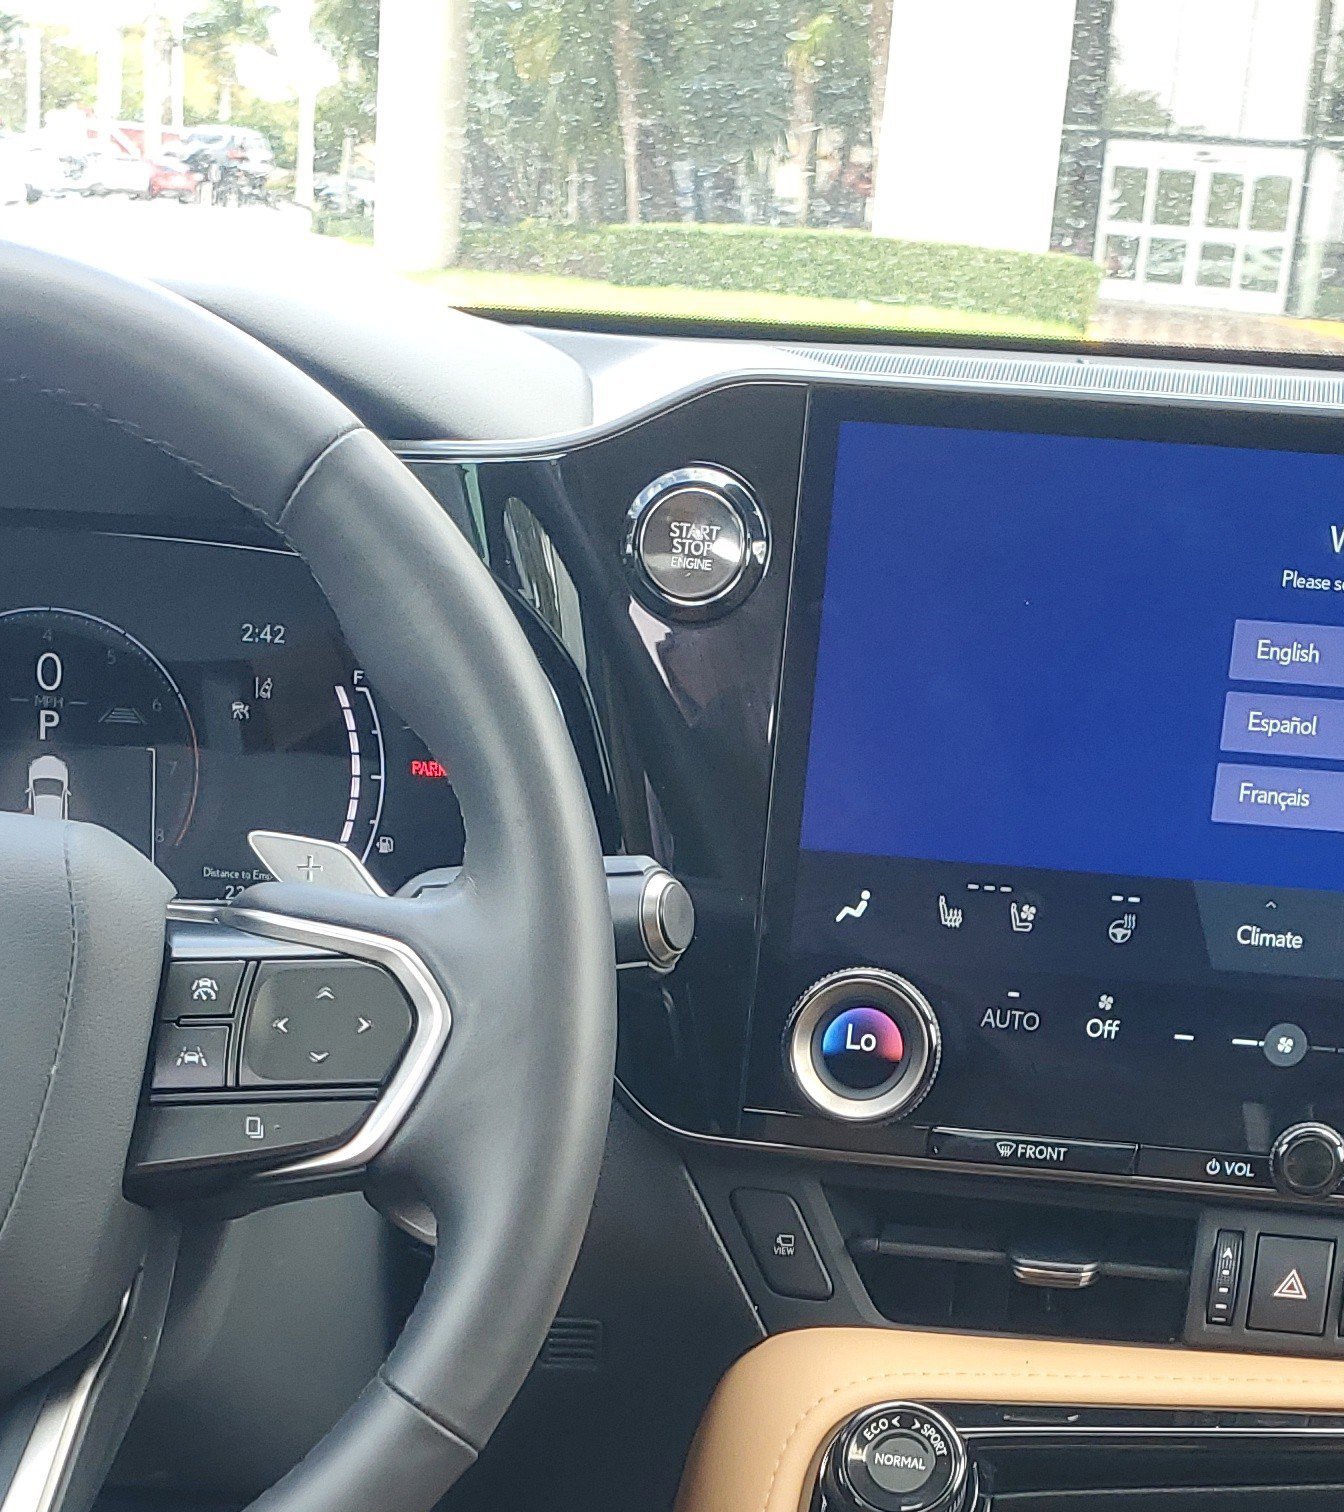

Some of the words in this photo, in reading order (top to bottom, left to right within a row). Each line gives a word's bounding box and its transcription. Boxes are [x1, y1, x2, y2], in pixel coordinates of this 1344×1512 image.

[670, 522, 721, 540] START
[672, 538, 713, 556] STOP
[671, 556, 713, 571] ENGINE
[1282, 569, 1331, 591] Please
[241, 623, 286, 645] 2:42
[1256, 639, 1320, 665] English
[36, 653, 63, 691] 0
[353, 670, 364, 684] F
[39, 709, 60, 740] P
[1247, 711, 1318, 736] Español
[1239, 782, 1310, 811] Français
[203, 866, 239, 880] Distance
[241, 870, 251, 880] to
[1236, 925, 1304, 950] Climate
[980, 1008, 1041, 1032] AUTO
[1085, 1017, 1121, 1041] Off
[846, 1023, 877, 1052] Lo
[1016, 1142, 1068, 1162] FRONT
[1224, 1160, 1255, 1178] VOL
[773, 1246, 795, 1256] VIEW
[863, 1418, 890, 1441] ECO
[920, 1423, 949, 1457] SPORT
[874, 1452, 927, 1471] NORMAL
